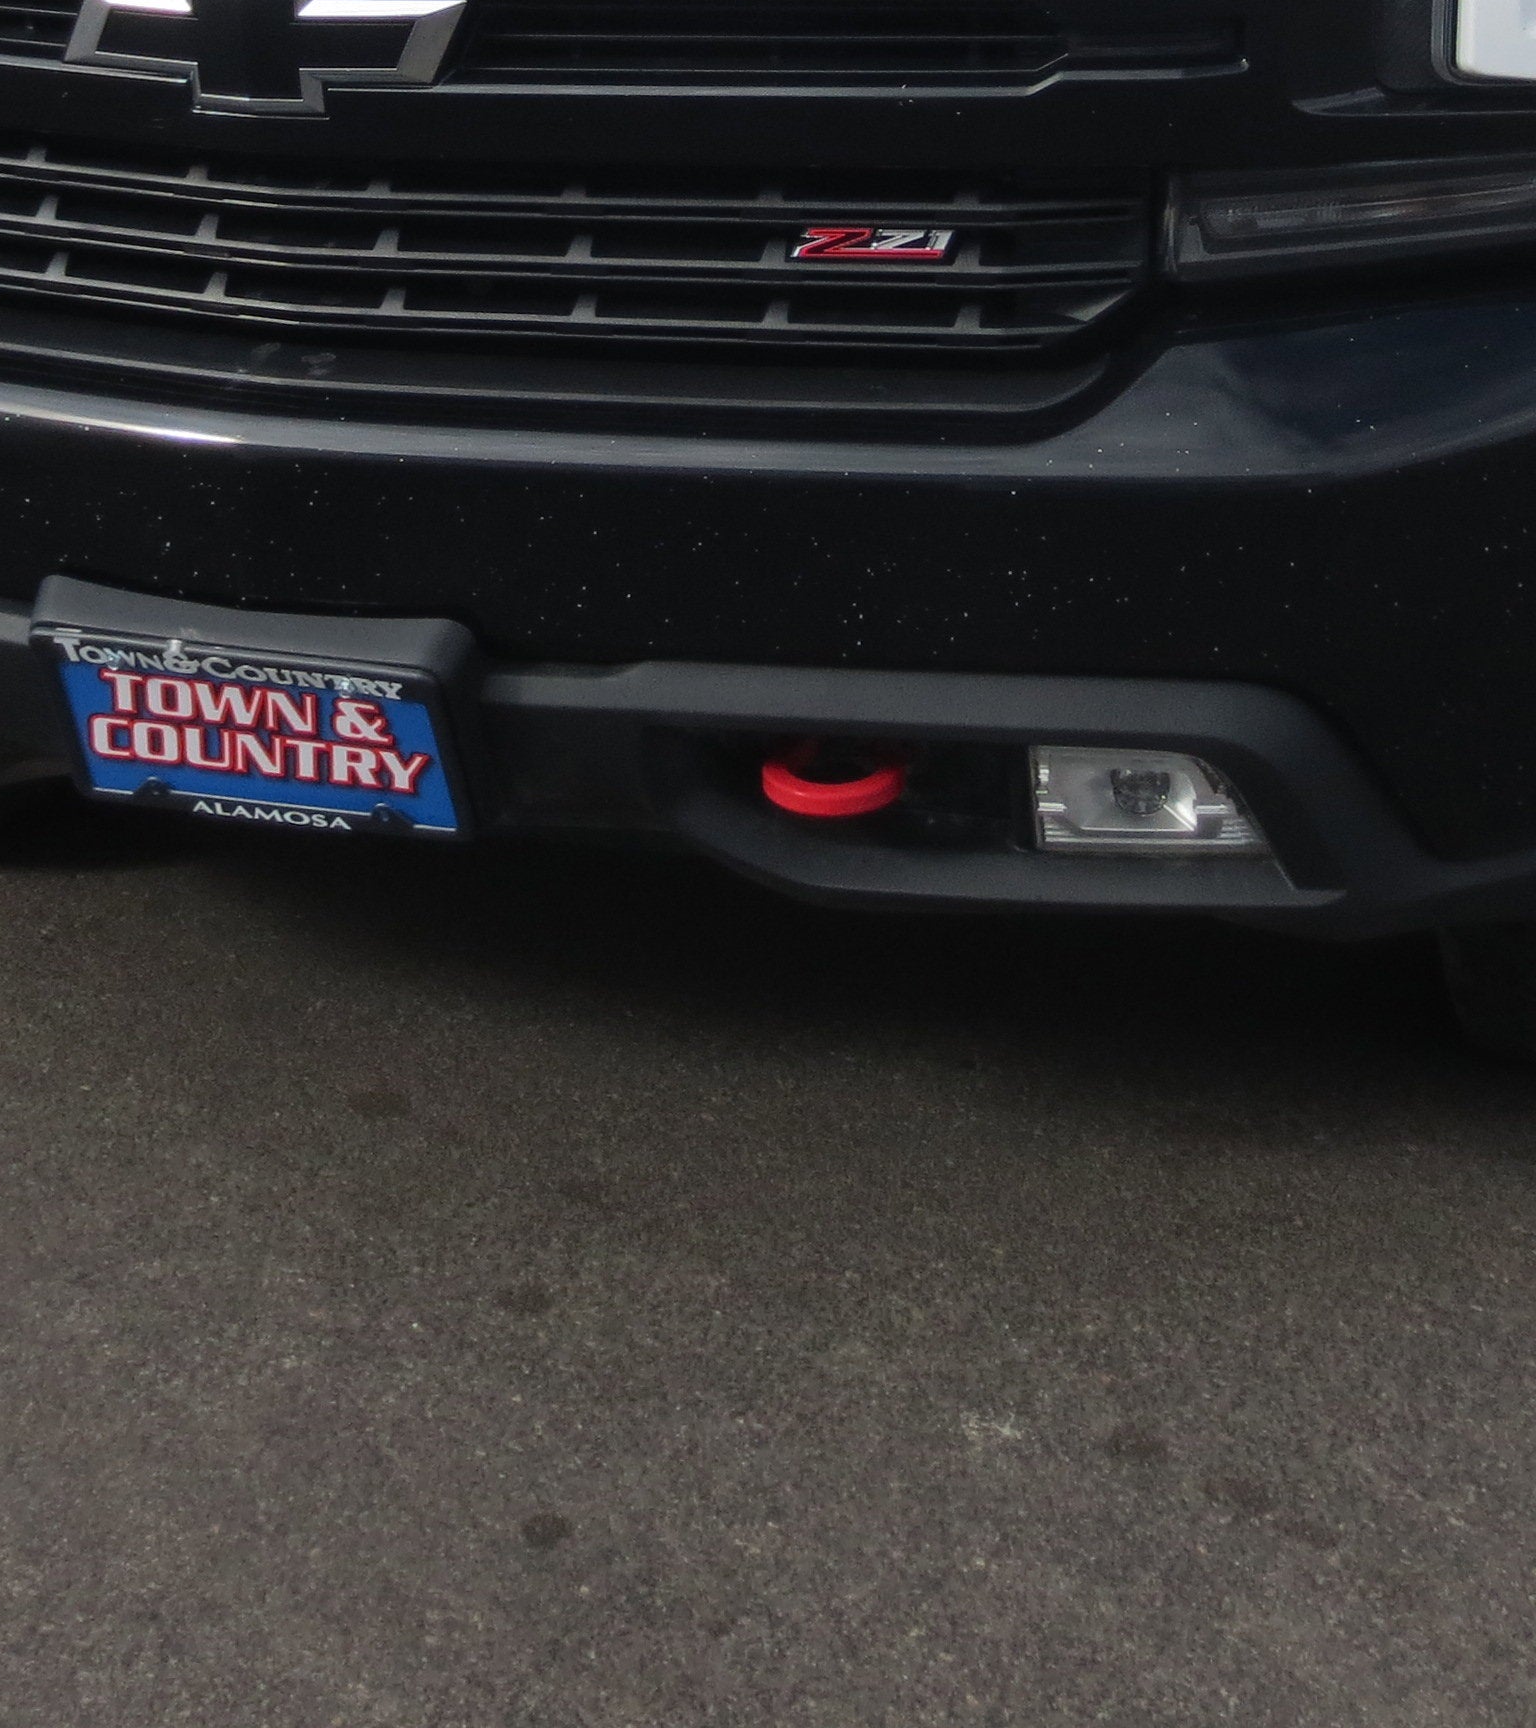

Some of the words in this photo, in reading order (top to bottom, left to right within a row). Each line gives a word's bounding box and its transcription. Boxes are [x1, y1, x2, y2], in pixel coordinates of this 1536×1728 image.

[790, 227, 955, 259] Z71
[99, 668, 319, 736] TOWN
[333, 696, 394, 745] &
[89, 713, 431, 795] COUNTRY
[193, 800, 353, 832] ALAMOSA
